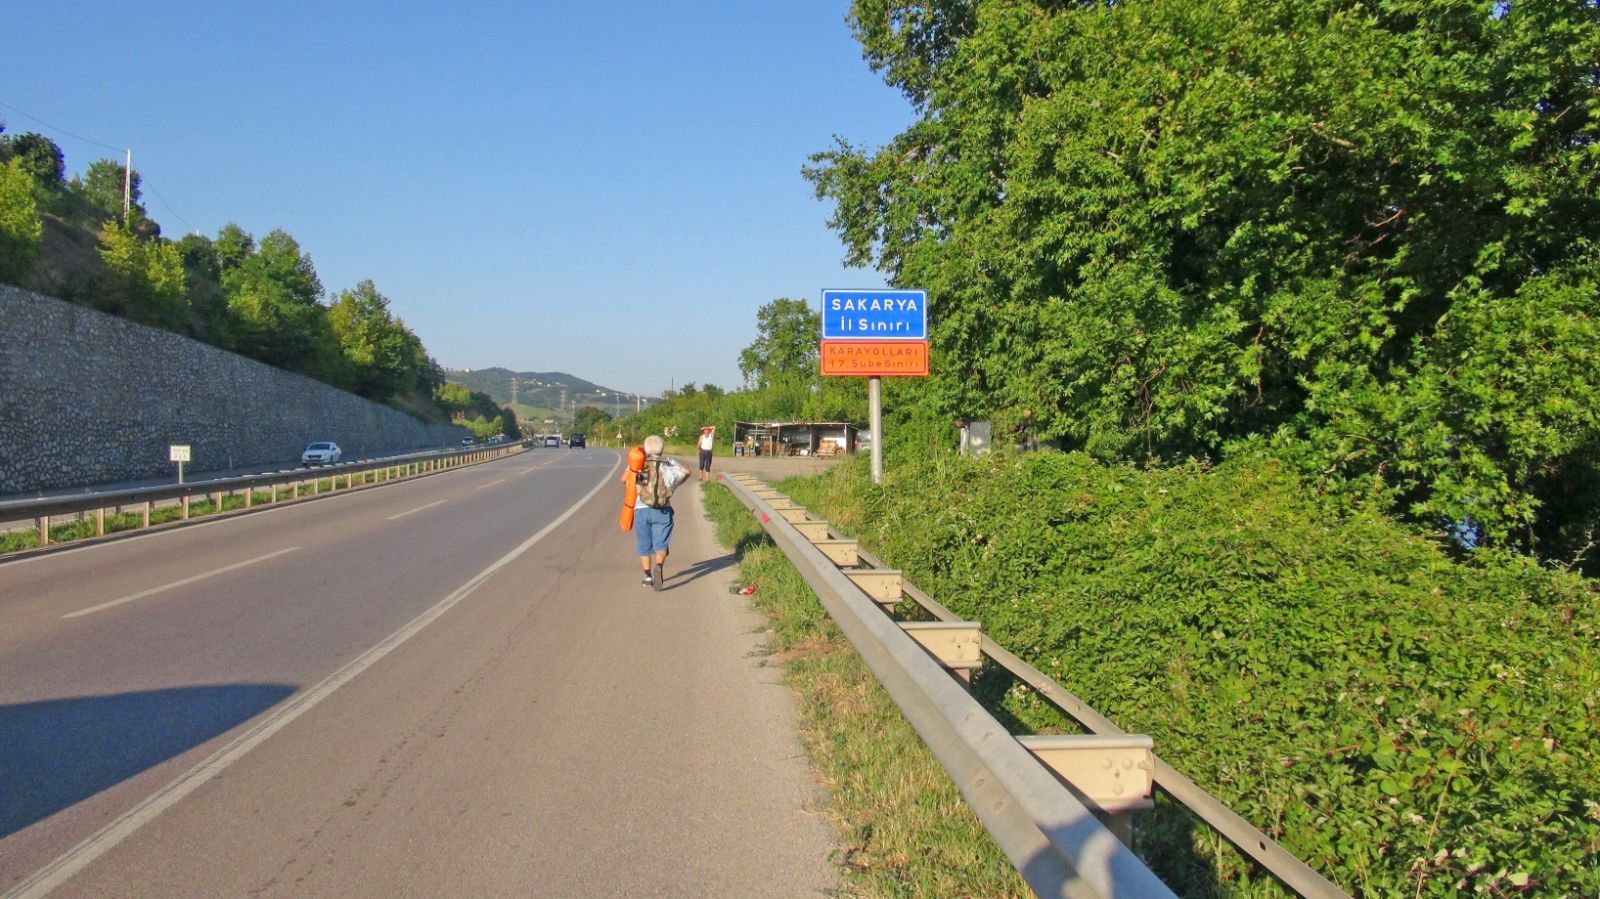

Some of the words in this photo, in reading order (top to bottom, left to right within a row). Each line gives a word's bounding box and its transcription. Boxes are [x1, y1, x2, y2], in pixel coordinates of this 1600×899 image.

[831, 298, 918, 311] SAKARYA
[840, 315, 852, 331] İl
[858, 318, 910, 331] Sınırı
[830, 347, 918, 357] KARAYOLLARI
